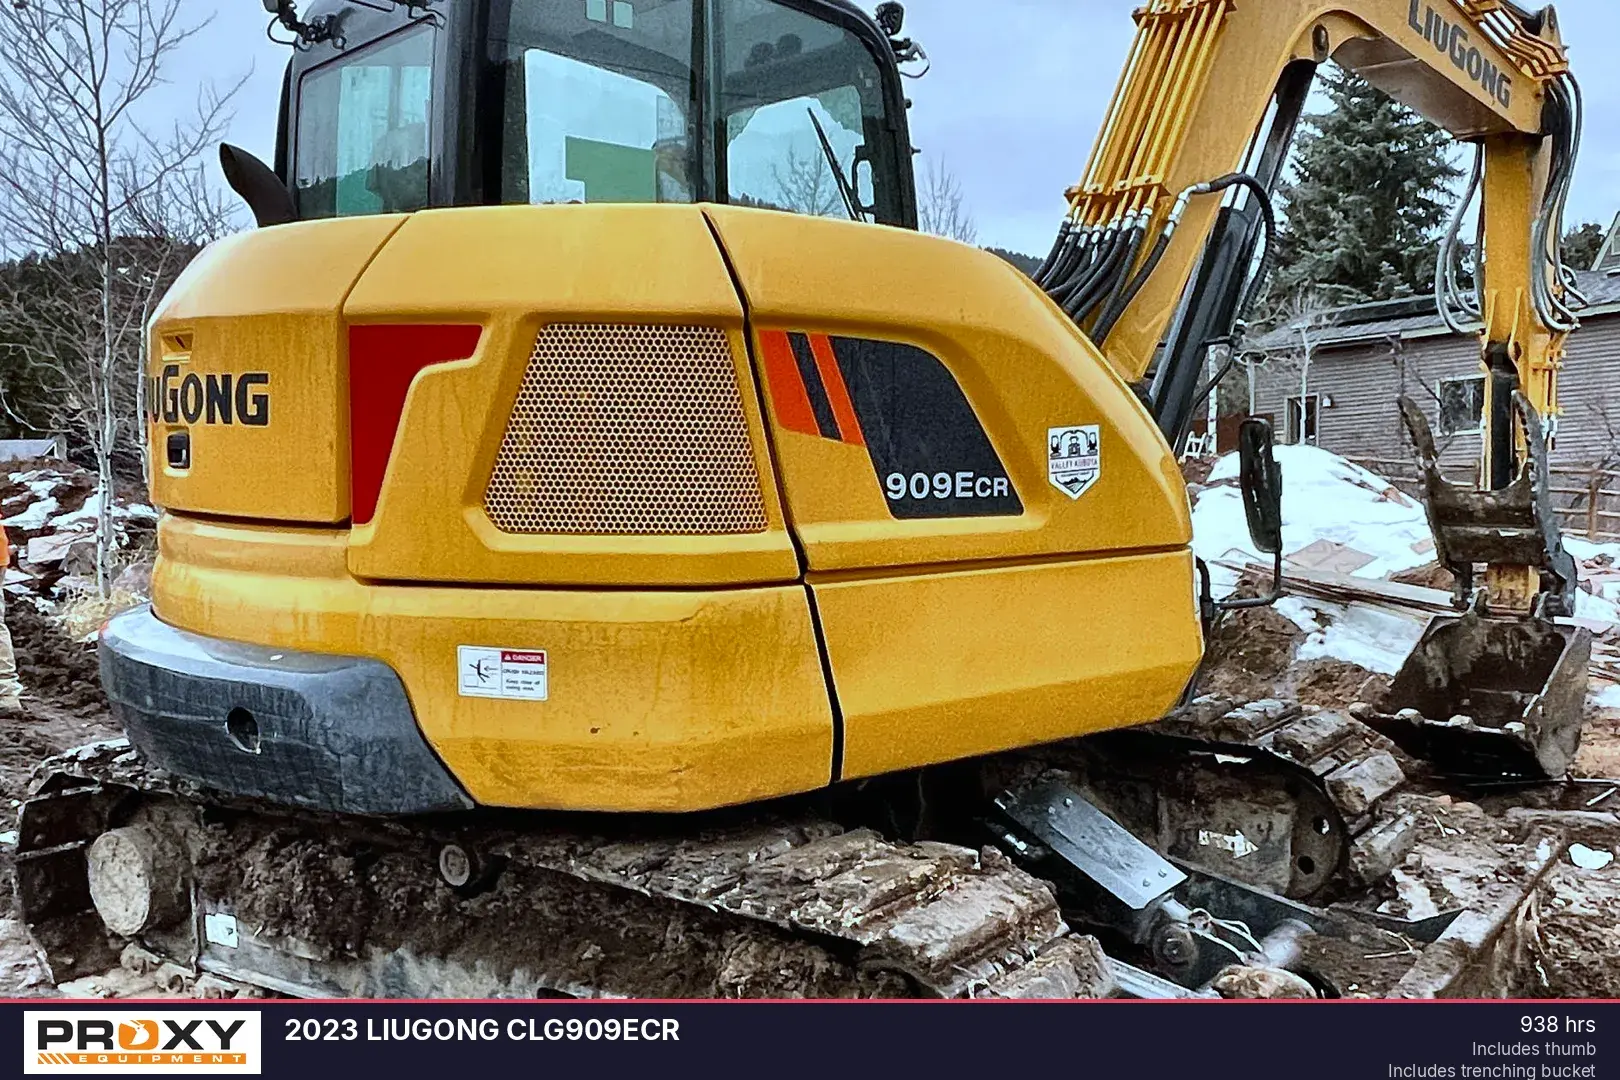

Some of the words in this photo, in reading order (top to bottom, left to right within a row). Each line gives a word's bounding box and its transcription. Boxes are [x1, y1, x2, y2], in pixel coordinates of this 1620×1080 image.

[1408, 0, 1512, 109] LIUGONG
[147, 364, 269, 426] UGONG
[886, 471, 1009, 500] 909ECR
[512, 654, 542, 662] DANGER
